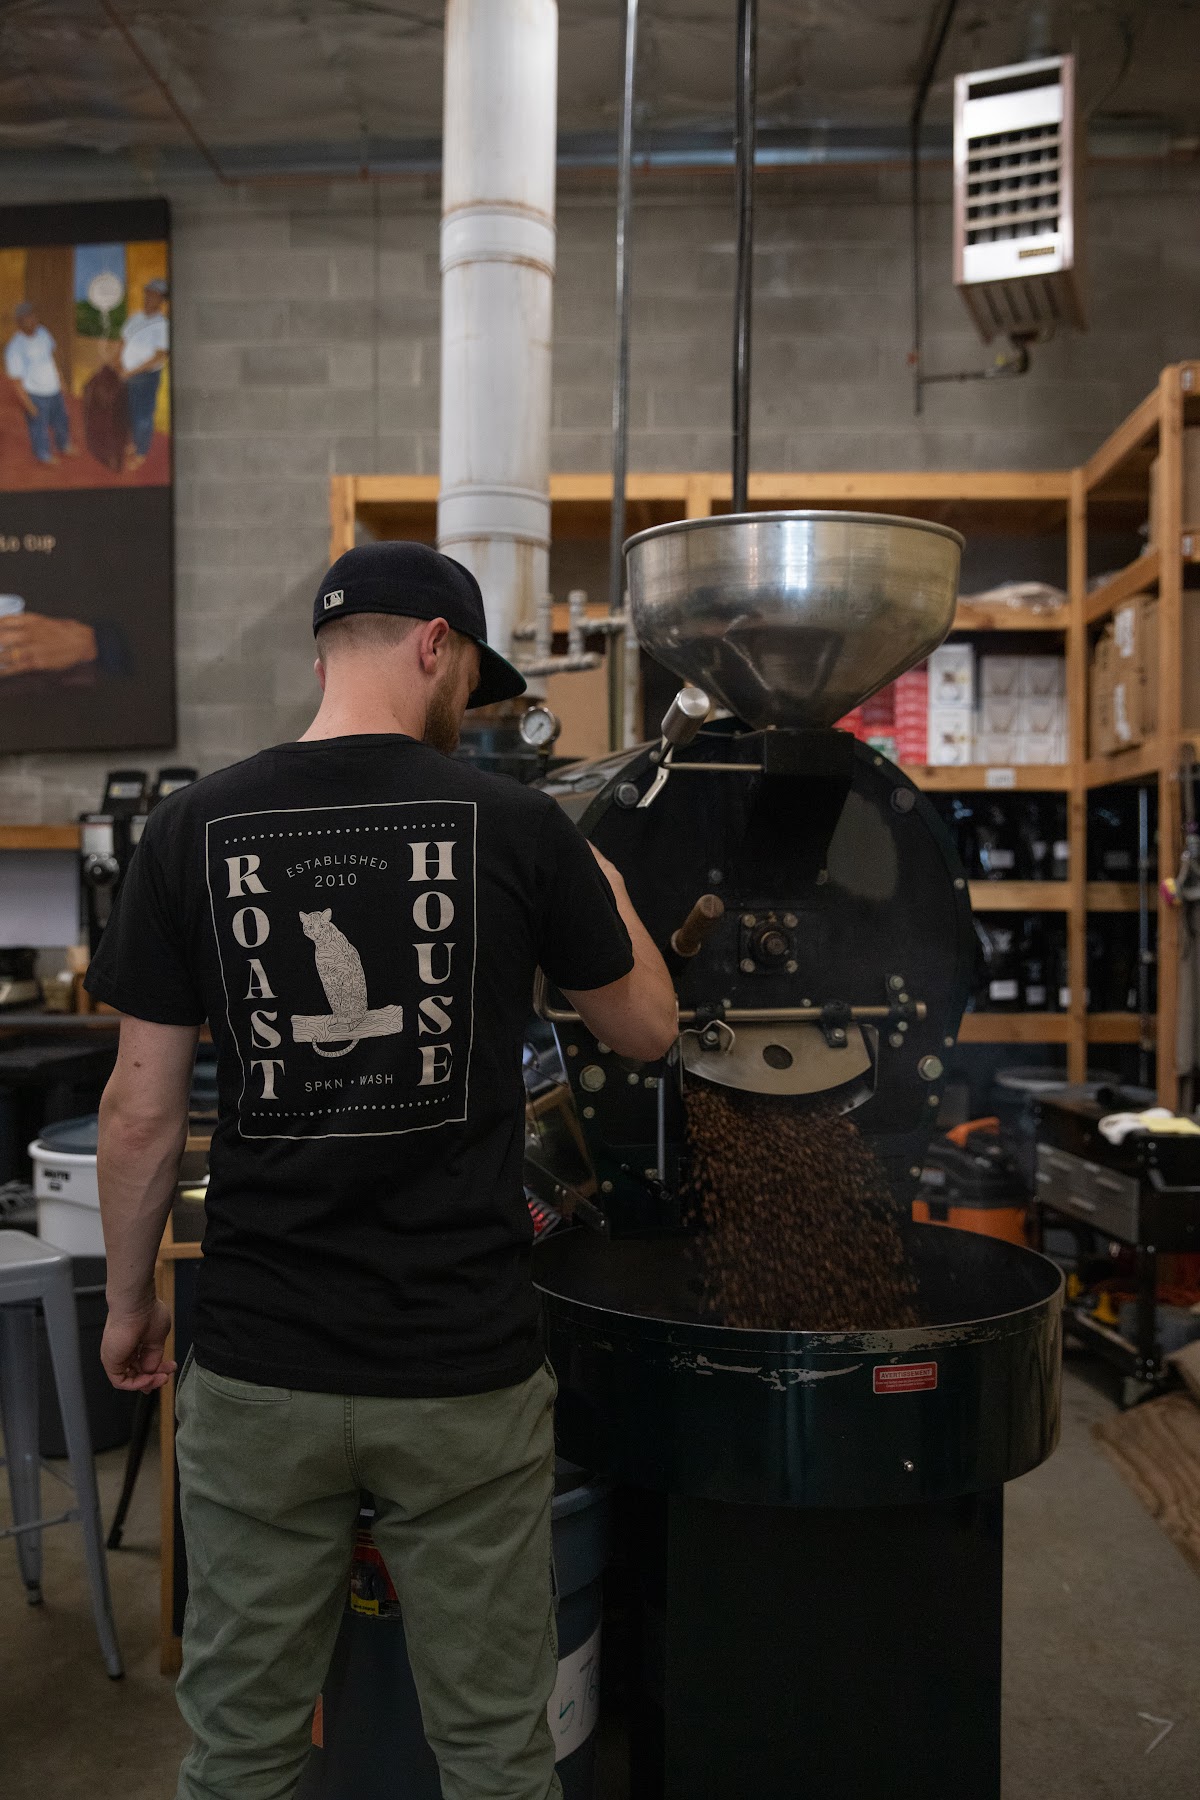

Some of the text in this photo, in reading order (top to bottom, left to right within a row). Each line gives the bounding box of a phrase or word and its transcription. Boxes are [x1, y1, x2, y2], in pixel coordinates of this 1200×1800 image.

[286, 854, 389, 878] ESTABLISHED
[314, 873, 358, 888] 2010
[407, 841, 458, 1087] HOUSE
[224, 854, 286, 1100] ROAST
[304, 1073, 394, 1093] SPKN WASH
[880, 1369, 931, 1379] AVERTISSEMENT
